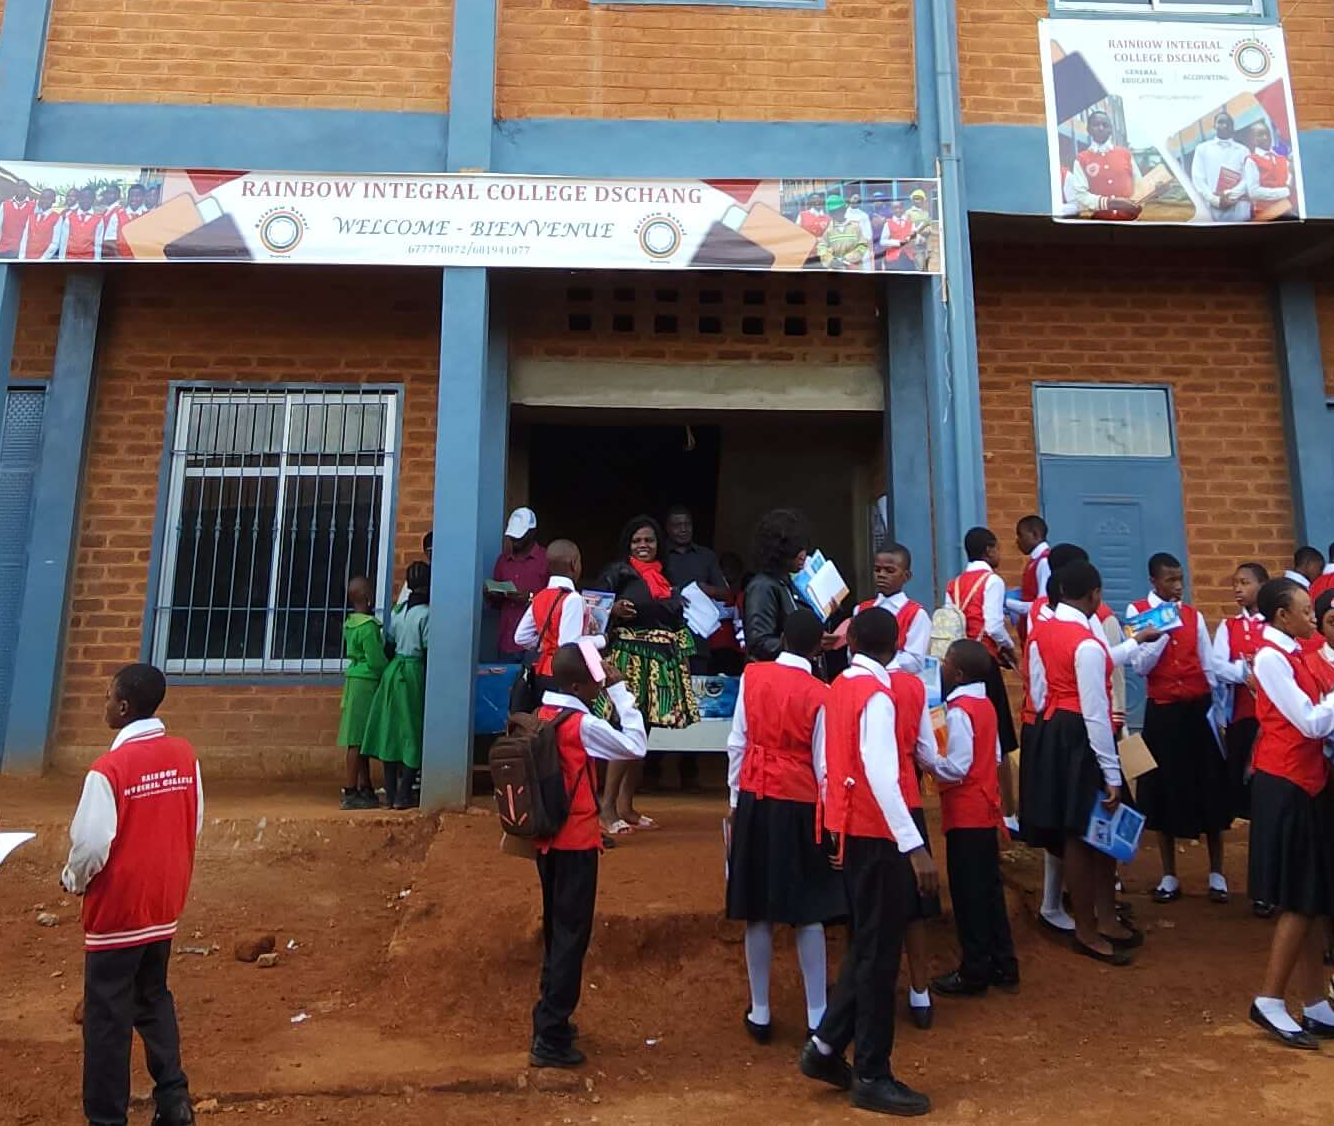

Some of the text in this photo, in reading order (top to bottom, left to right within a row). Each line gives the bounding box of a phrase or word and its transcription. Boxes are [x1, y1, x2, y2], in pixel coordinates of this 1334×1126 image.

[1107, 39, 1223, 51] RAINBOW INTEGRAL
[1113, 52, 1221, 64] COLLEGE DSCHANG
[241, 180, 702, 204] RAINBOW INTEGRAL COLLEGE DSCHANG
[332, 216, 451, 236] WELCOME
[469, 219, 616, 239] BIENVENUE
